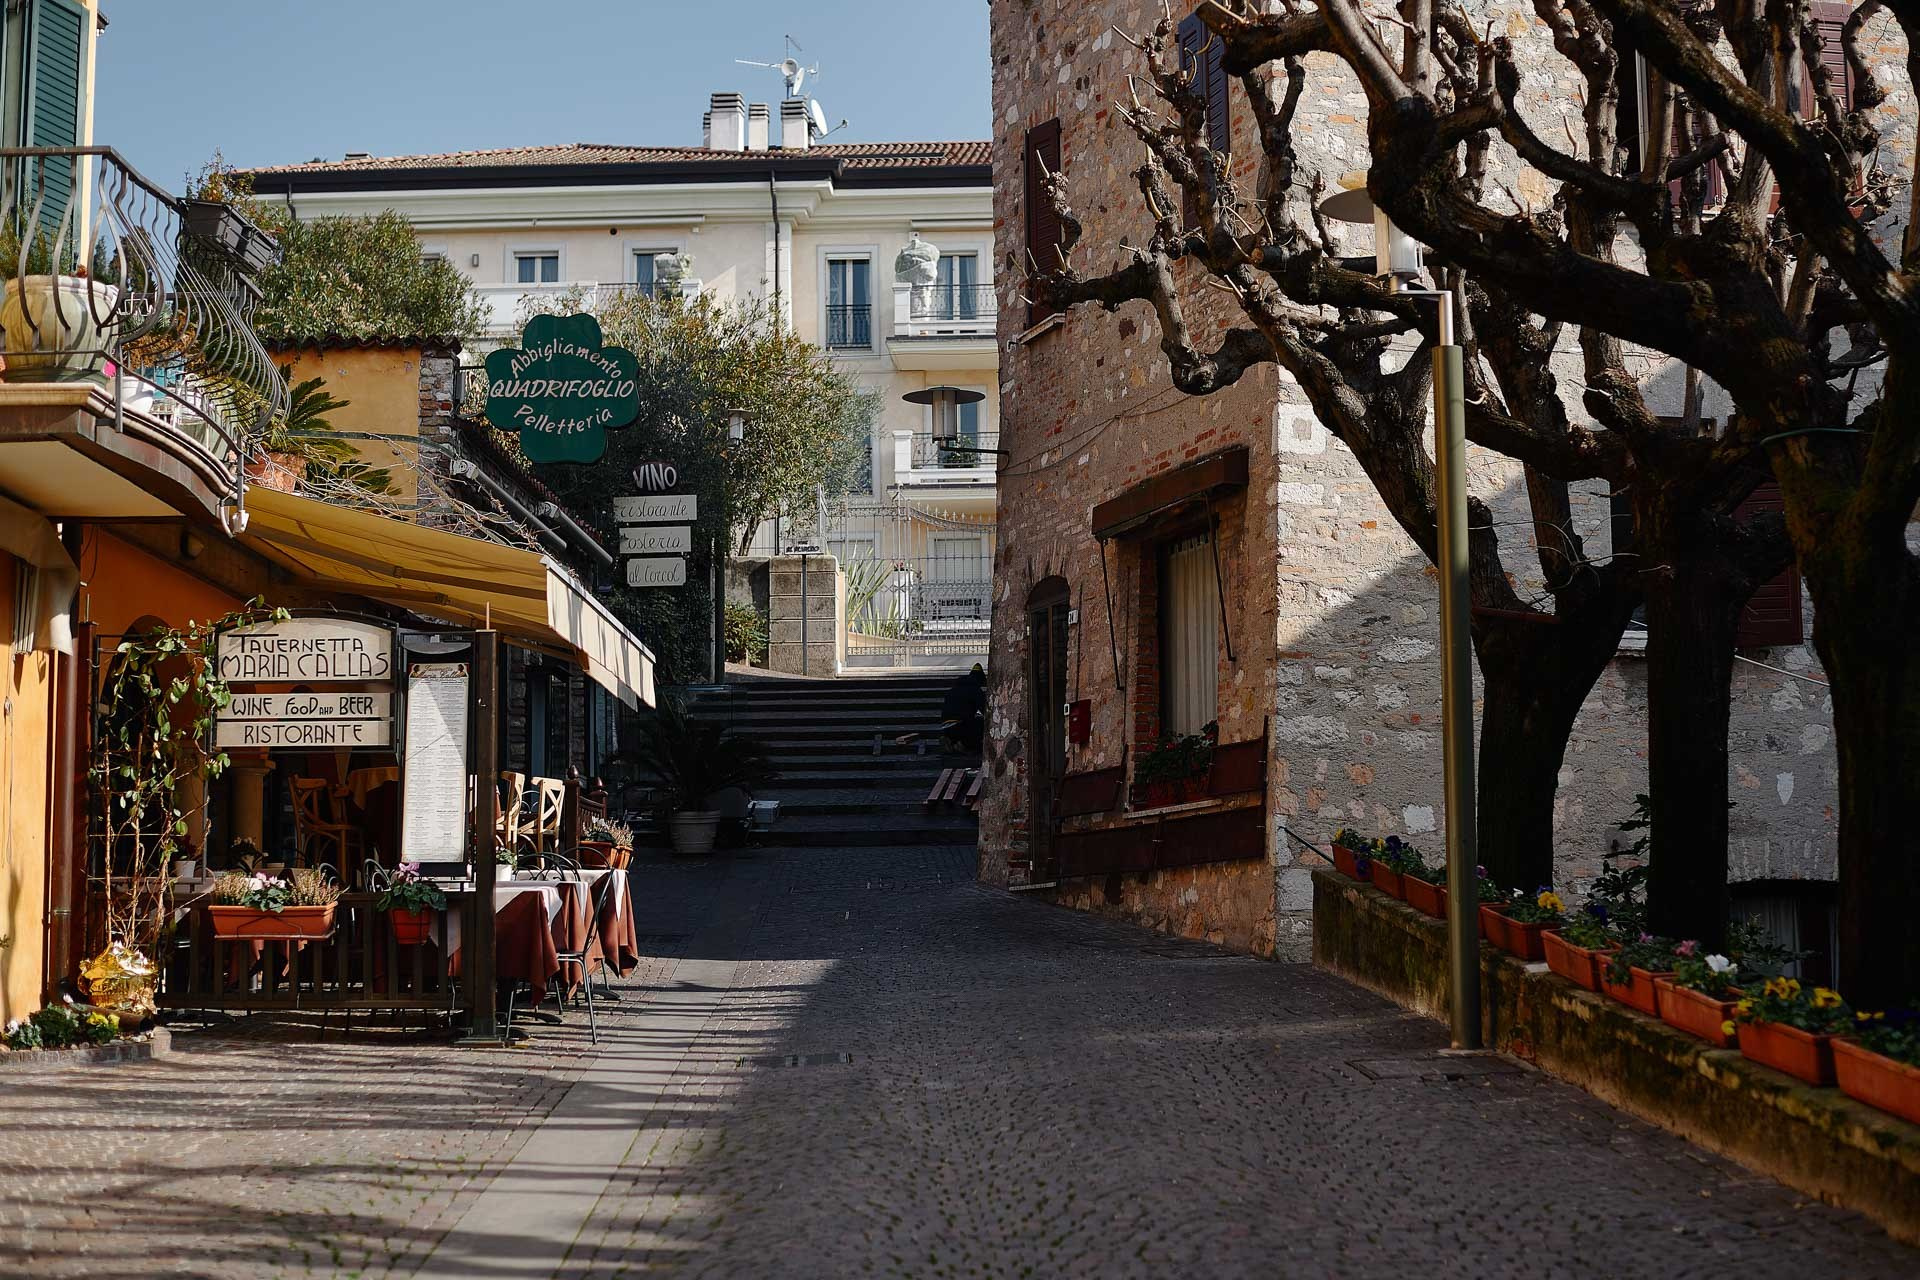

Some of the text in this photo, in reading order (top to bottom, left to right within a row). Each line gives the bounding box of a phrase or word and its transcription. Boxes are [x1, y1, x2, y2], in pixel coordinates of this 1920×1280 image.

[510, 337, 622, 379] Abbigliamento
[489, 379, 635, 398] QUADRIFOGLIO
[513, 403, 613, 435] Pelletteria
[632, 463, 677, 491] VINO
[620, 498, 688, 518] ristorante
[628, 532, 682, 550] osteria
[220, 652, 389, 678] MARIA CALLAS
[339, 696, 374, 716] BEER
[243, 724, 363, 745] RISTORANTE
